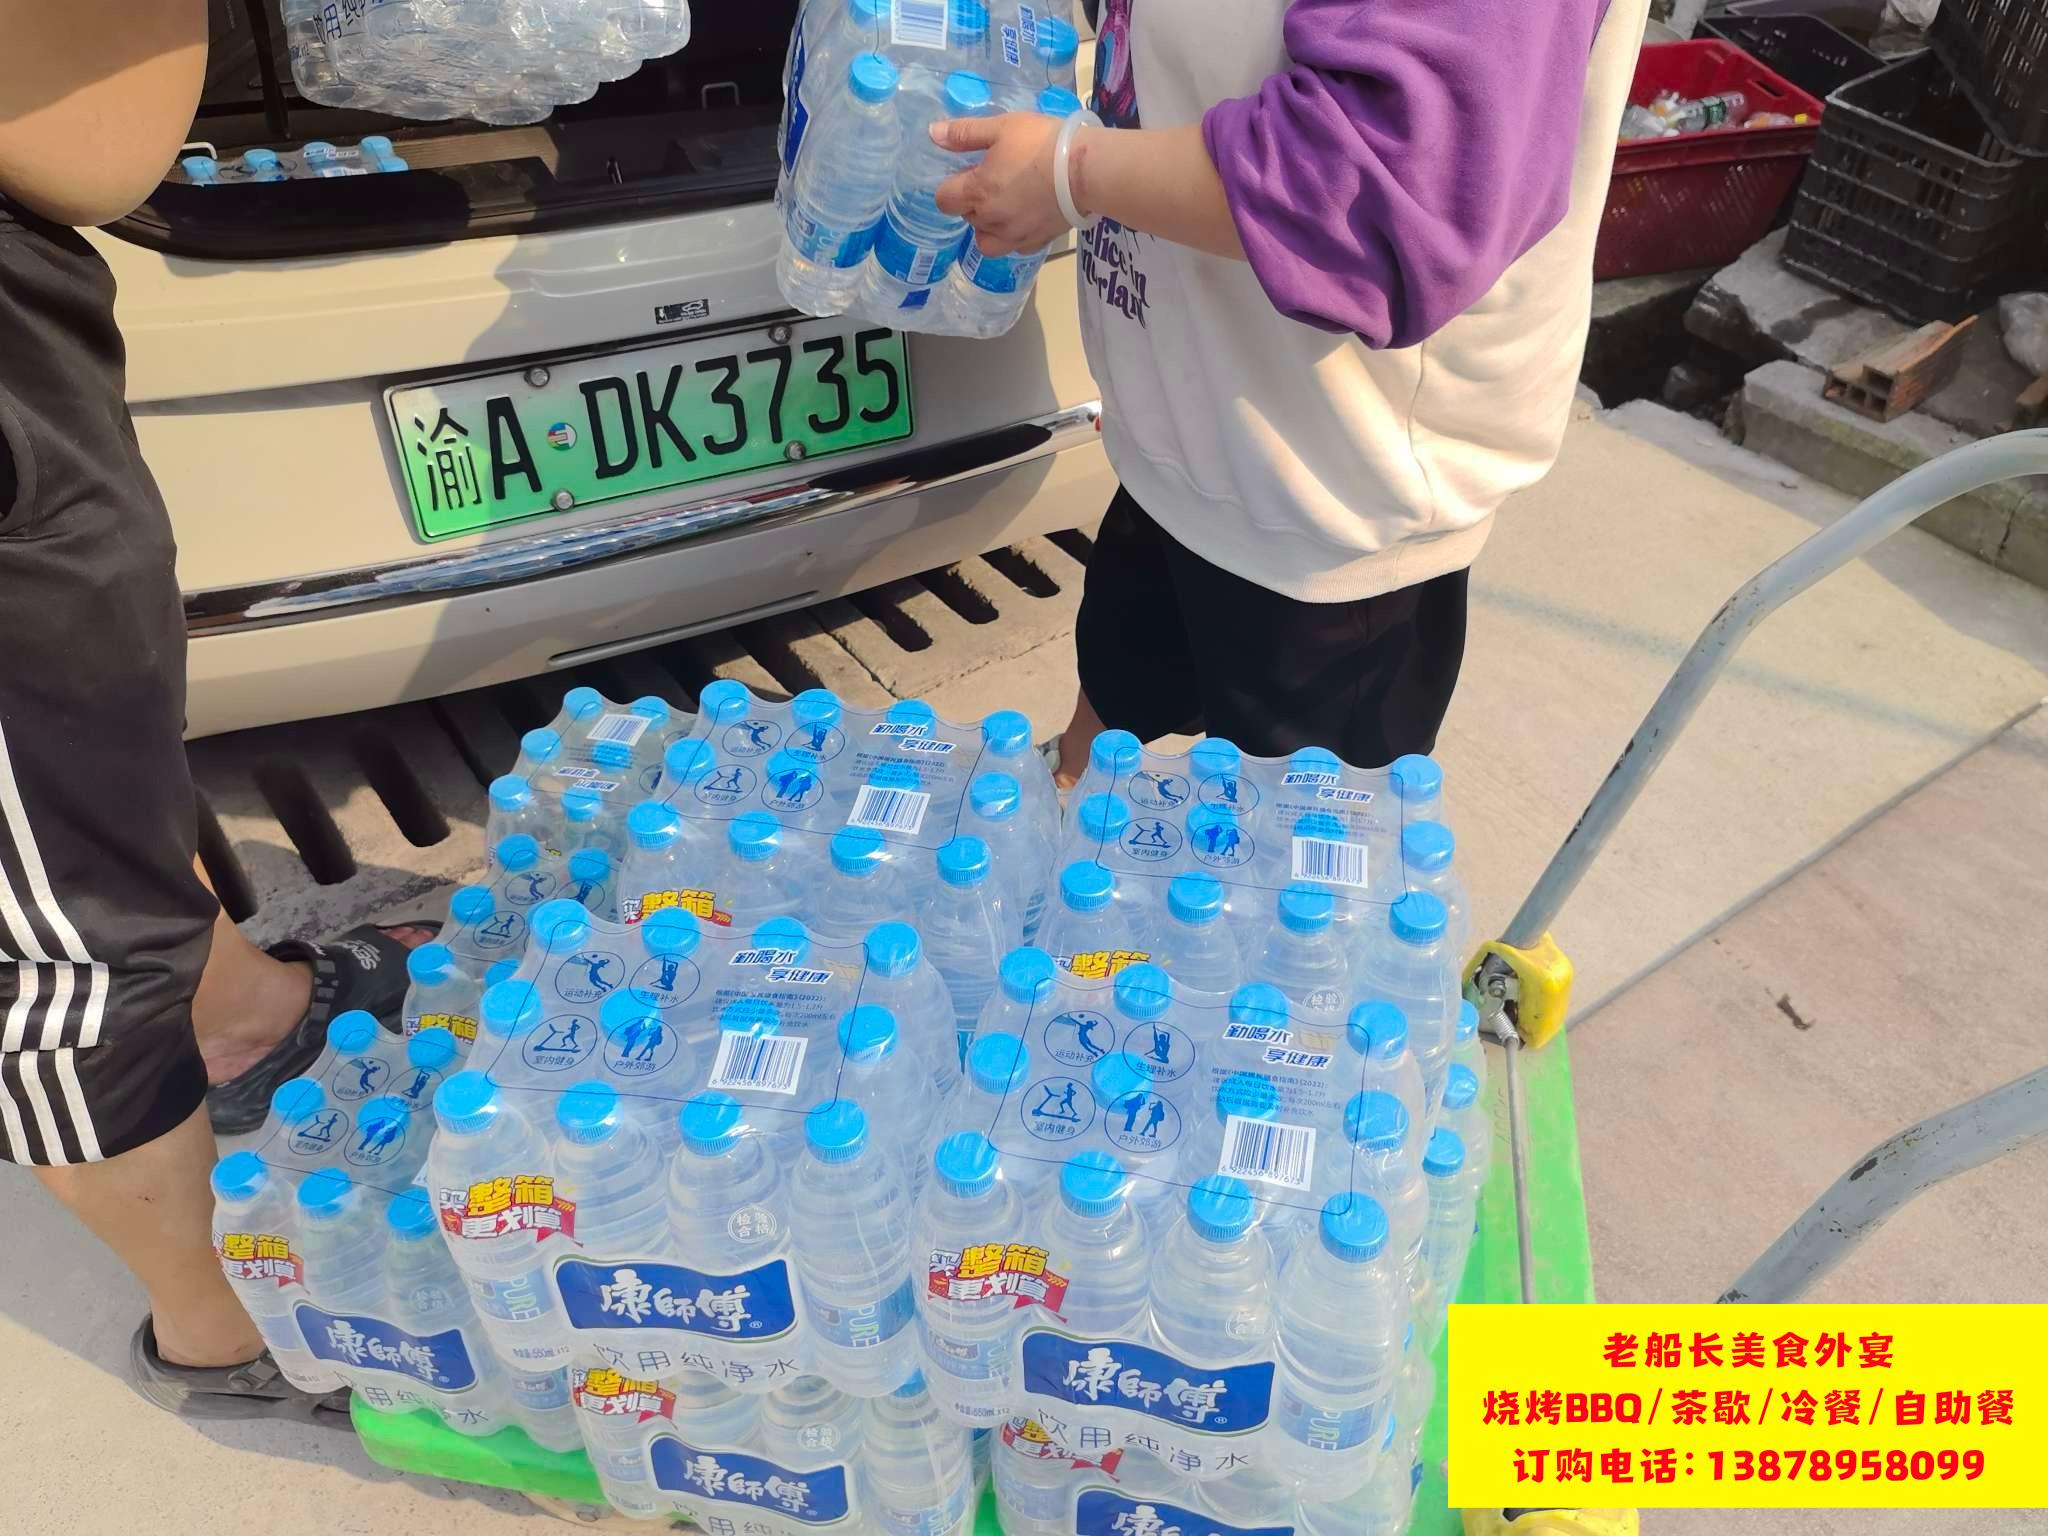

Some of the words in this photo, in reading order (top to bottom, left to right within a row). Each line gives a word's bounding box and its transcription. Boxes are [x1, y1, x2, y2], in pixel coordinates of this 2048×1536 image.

[730, 948, 798, 965] 勤喝水
[766, 967, 833, 984] 享健康
[1223, 1024, 1293, 1044] 勤喝水
[1262, 1047, 1333, 1069] 享健康
[461, 1205, 562, 1239] 更划算
[946, 1271, 1049, 1301] 更划算
[848, 1303, 880, 1348] PURE
[593, 1343, 799, 1384] 饮用纯净水
[1037, 1407, 1250, 1472] 饮用纯净水
